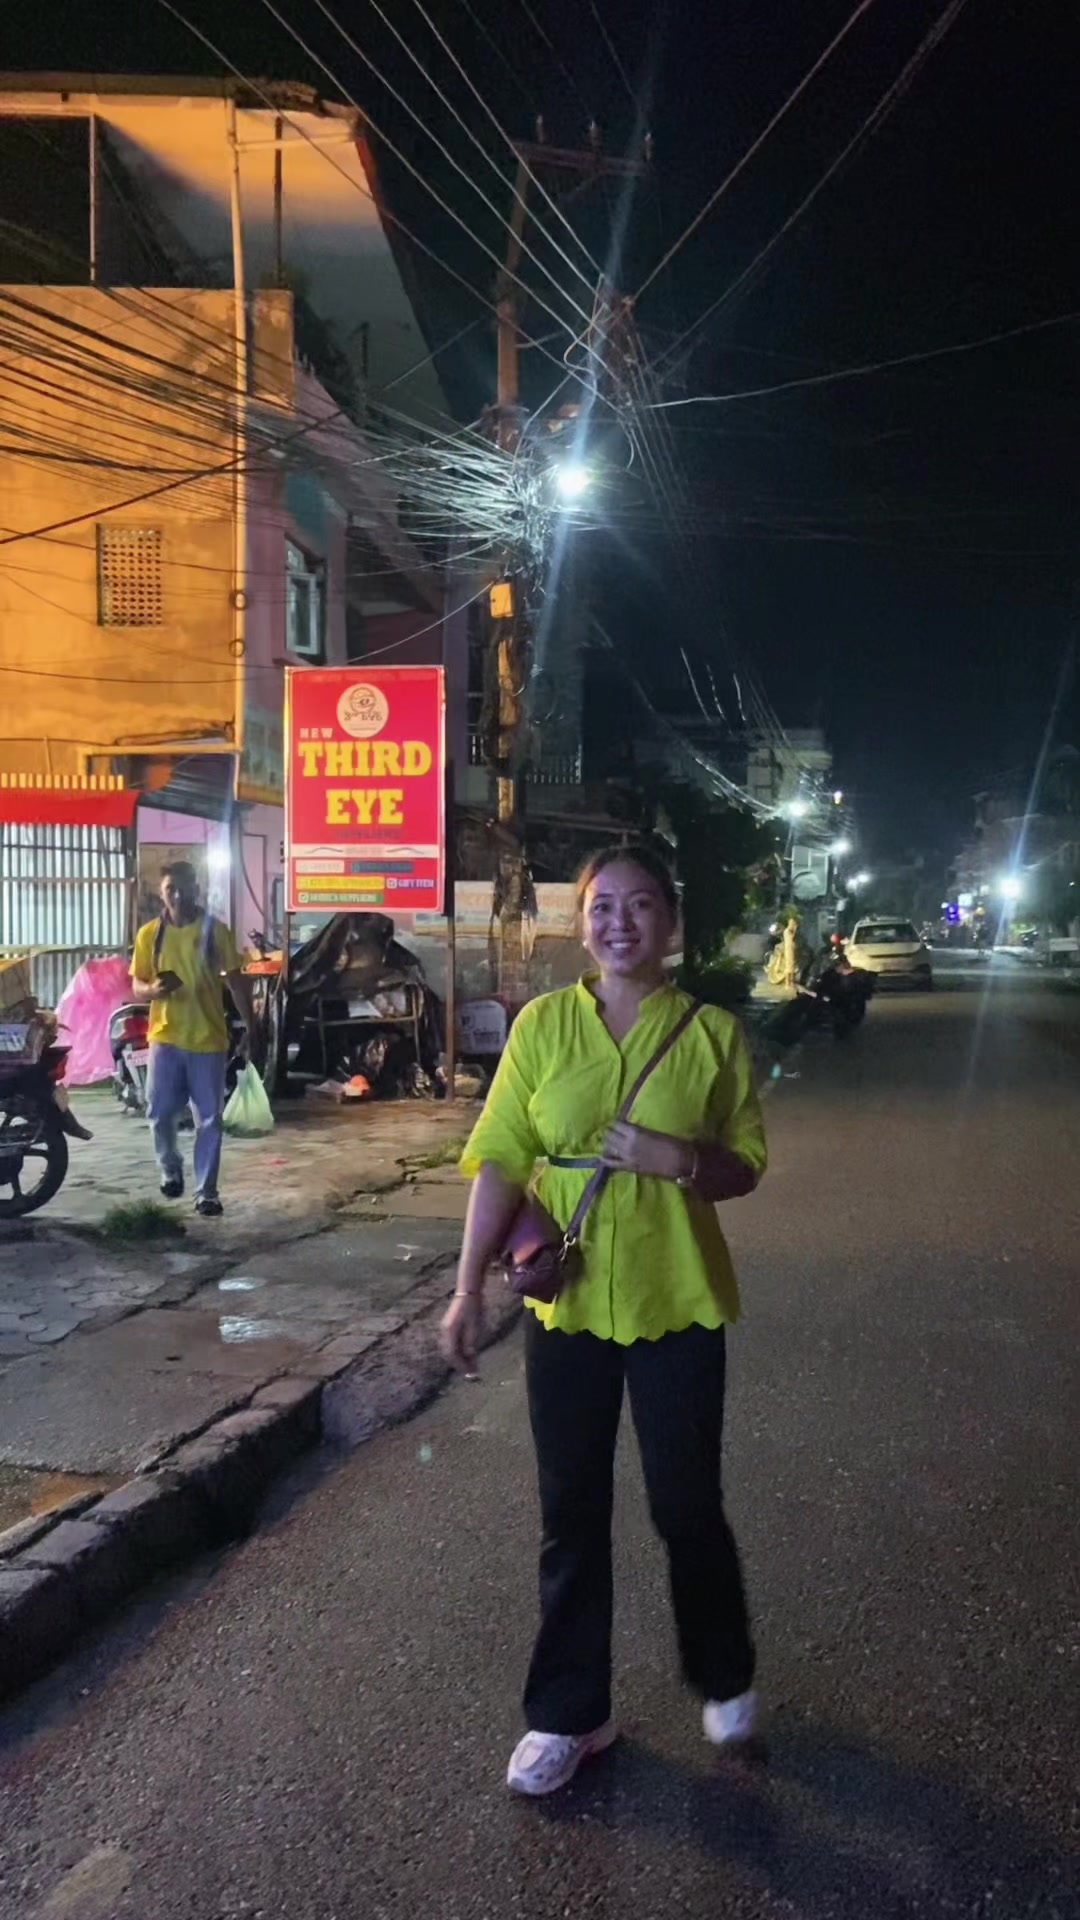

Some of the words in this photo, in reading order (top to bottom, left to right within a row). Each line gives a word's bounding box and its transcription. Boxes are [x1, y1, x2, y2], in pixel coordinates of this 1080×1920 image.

[300, 727, 333, 739] NEW
[298, 740, 432, 777] THIRD
[326, 788, 404, 825] EYE
